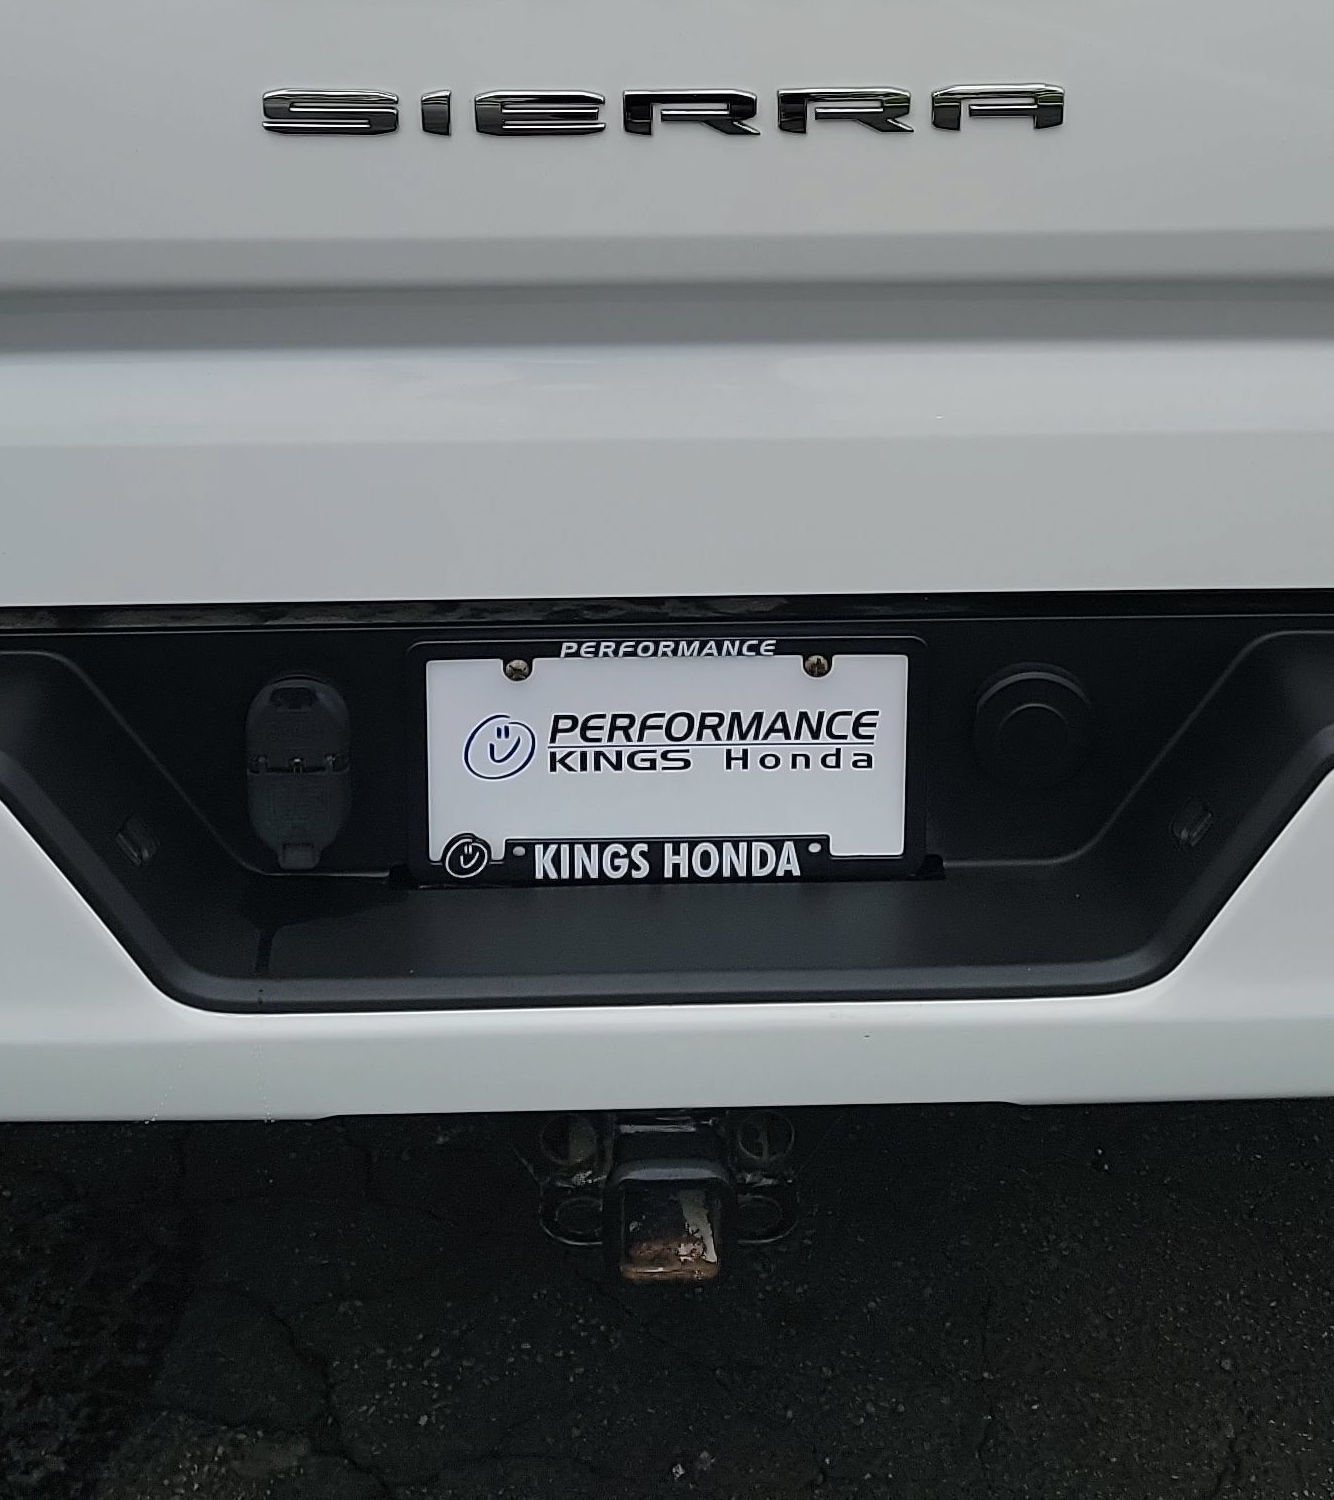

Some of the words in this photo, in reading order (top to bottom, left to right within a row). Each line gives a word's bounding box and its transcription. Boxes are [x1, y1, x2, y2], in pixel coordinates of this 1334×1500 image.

[262, 83, 1065, 138] SIERRA
[560, 639, 778, 659] PERFORMANCE
[549, 710, 880, 743] PERFORMANCE
[549, 749, 692, 773] KINGS
[725, 748, 874, 771] Honda
[535, 842, 651, 880] KINGS
[664, 841, 801, 879] HONDA
